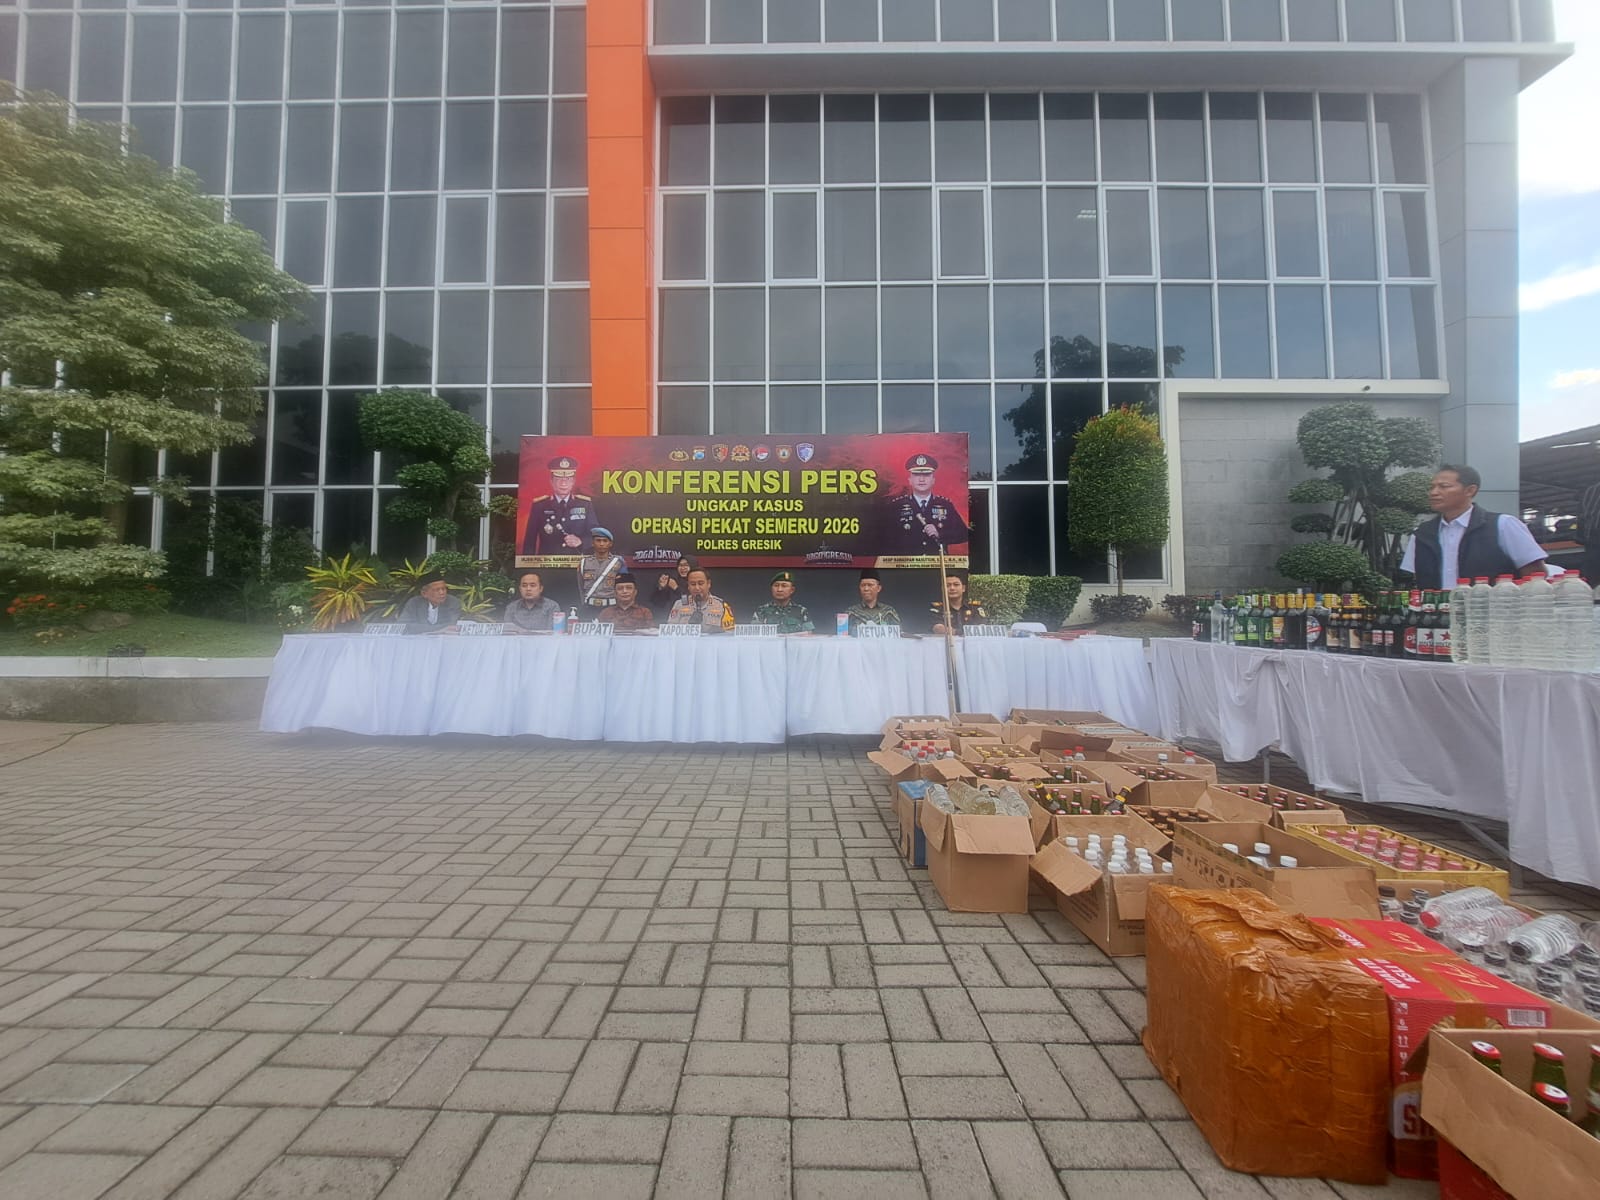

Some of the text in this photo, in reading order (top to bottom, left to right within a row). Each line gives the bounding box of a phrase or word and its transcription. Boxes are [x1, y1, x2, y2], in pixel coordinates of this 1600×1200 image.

[602, 469, 878, 494] KONFERENSI PERS
[686, 499, 804, 512] UNGKAP KASUS
[631, 517, 860, 534] OPERASI PEKAT SEMERU 2026
[697, 539, 782, 550] POLRES GRESIK
[574, 622, 613, 635] BUPATI
[660, 624, 700, 637] KAPOLRES
[859, 625, 899, 637] KETUA PN
